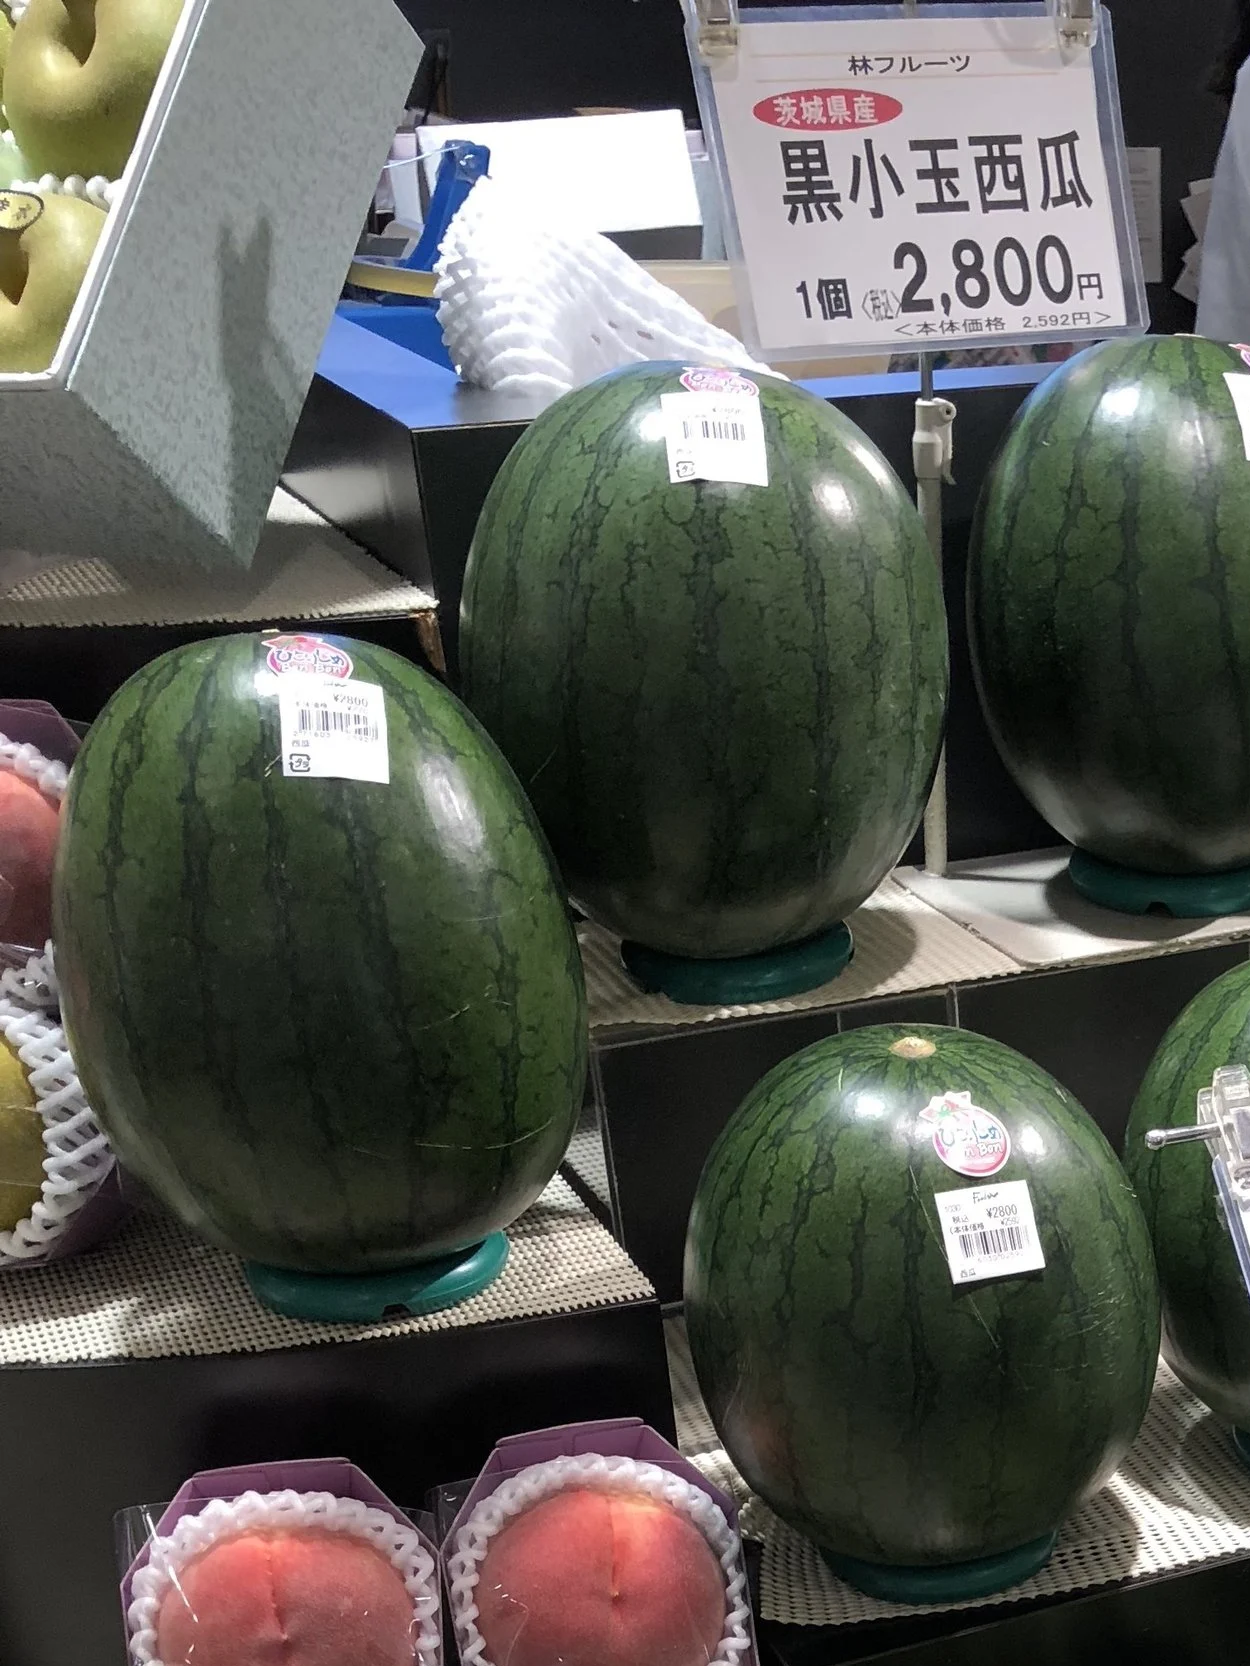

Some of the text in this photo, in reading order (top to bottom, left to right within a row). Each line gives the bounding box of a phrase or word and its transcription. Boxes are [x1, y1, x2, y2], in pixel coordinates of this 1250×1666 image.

[848, 55, 971, 75] 林フルーツ
[774, 95, 878, 126] 茨城県産
[780, 130, 1093, 226] 黒小玉西瓜
[986, 1204, 1018, 1218] ¥2800
